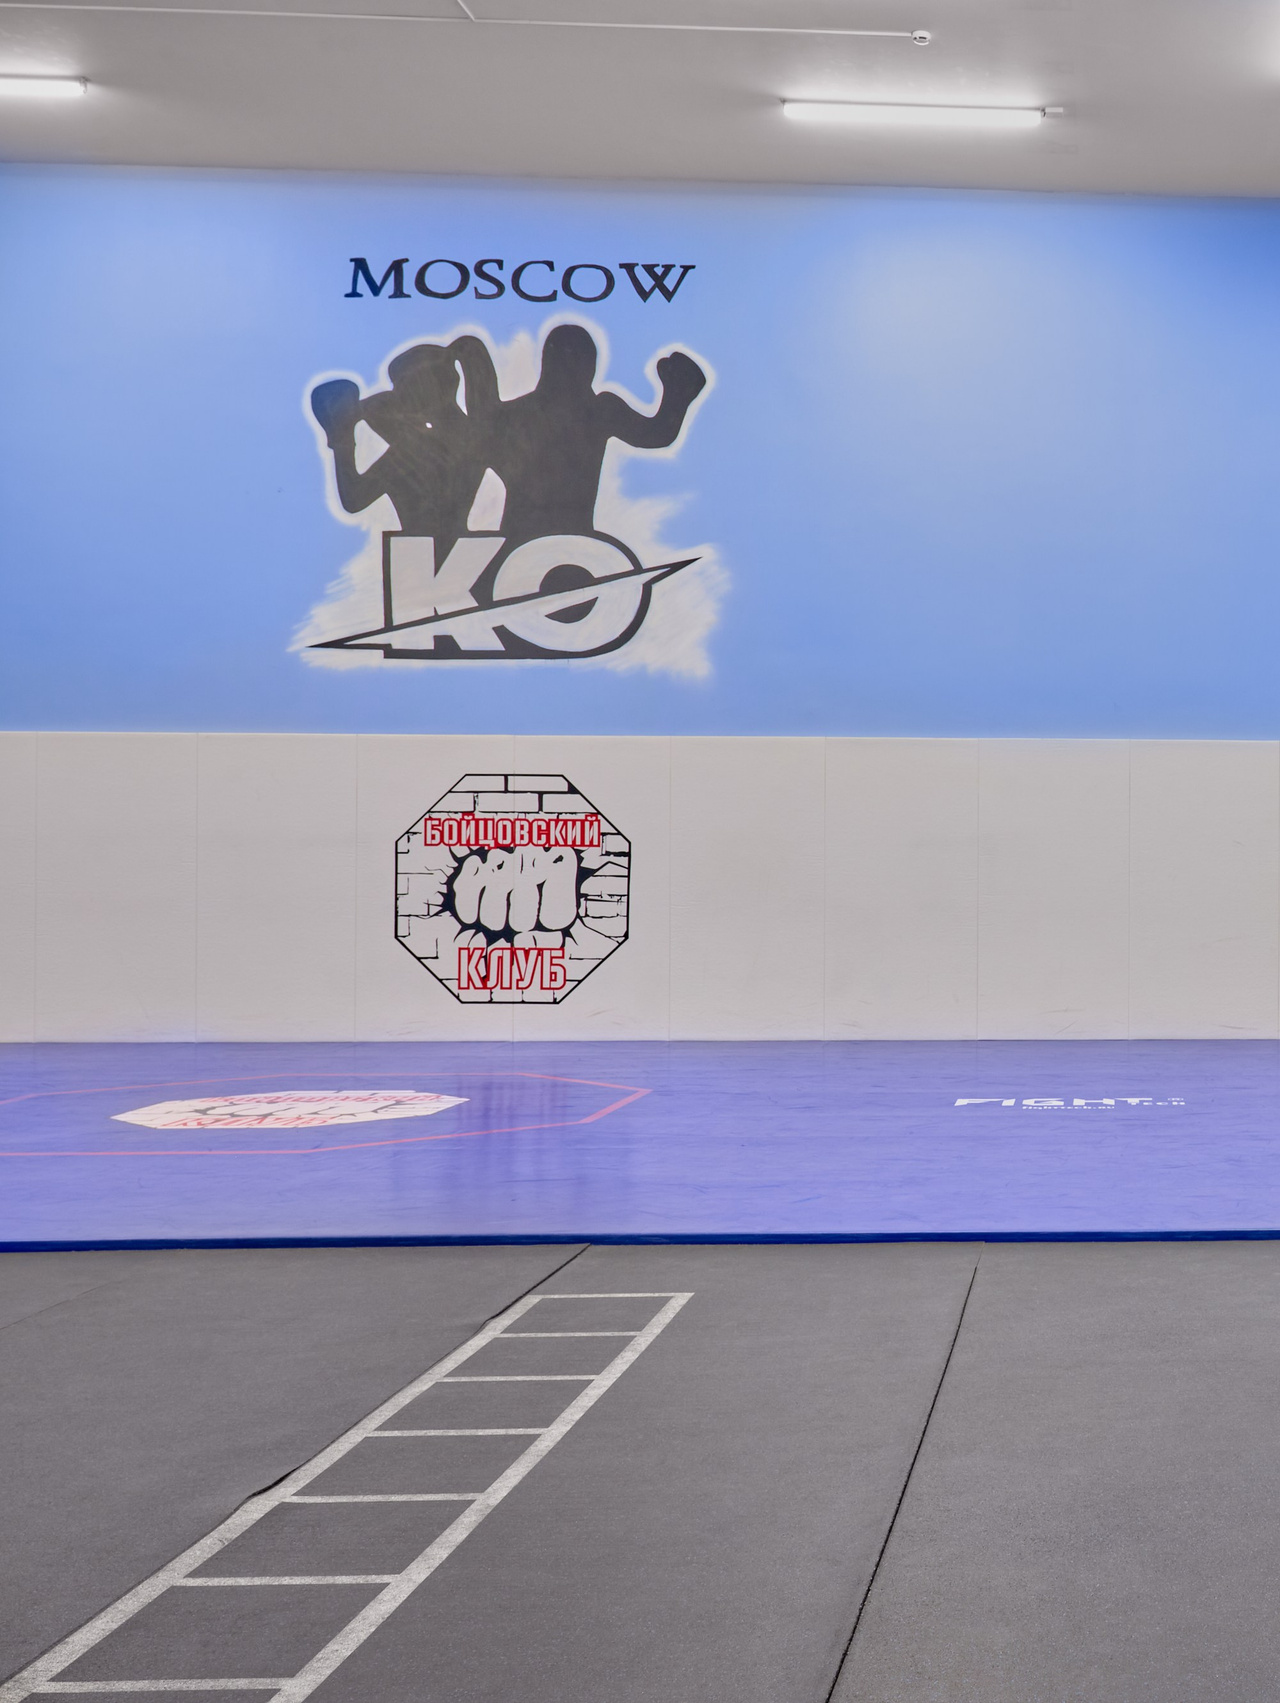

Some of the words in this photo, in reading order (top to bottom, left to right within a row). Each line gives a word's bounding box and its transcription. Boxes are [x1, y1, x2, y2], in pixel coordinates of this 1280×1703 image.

[344, 257, 697, 303] MOSCOW
[382, 531, 653, 659] KO
[424, 812, 601, 850] БОЙЦОВСКИЙ
[457, 946, 567, 991] КЛУБ
[954, 1097, 1153, 1106] FIGHT
